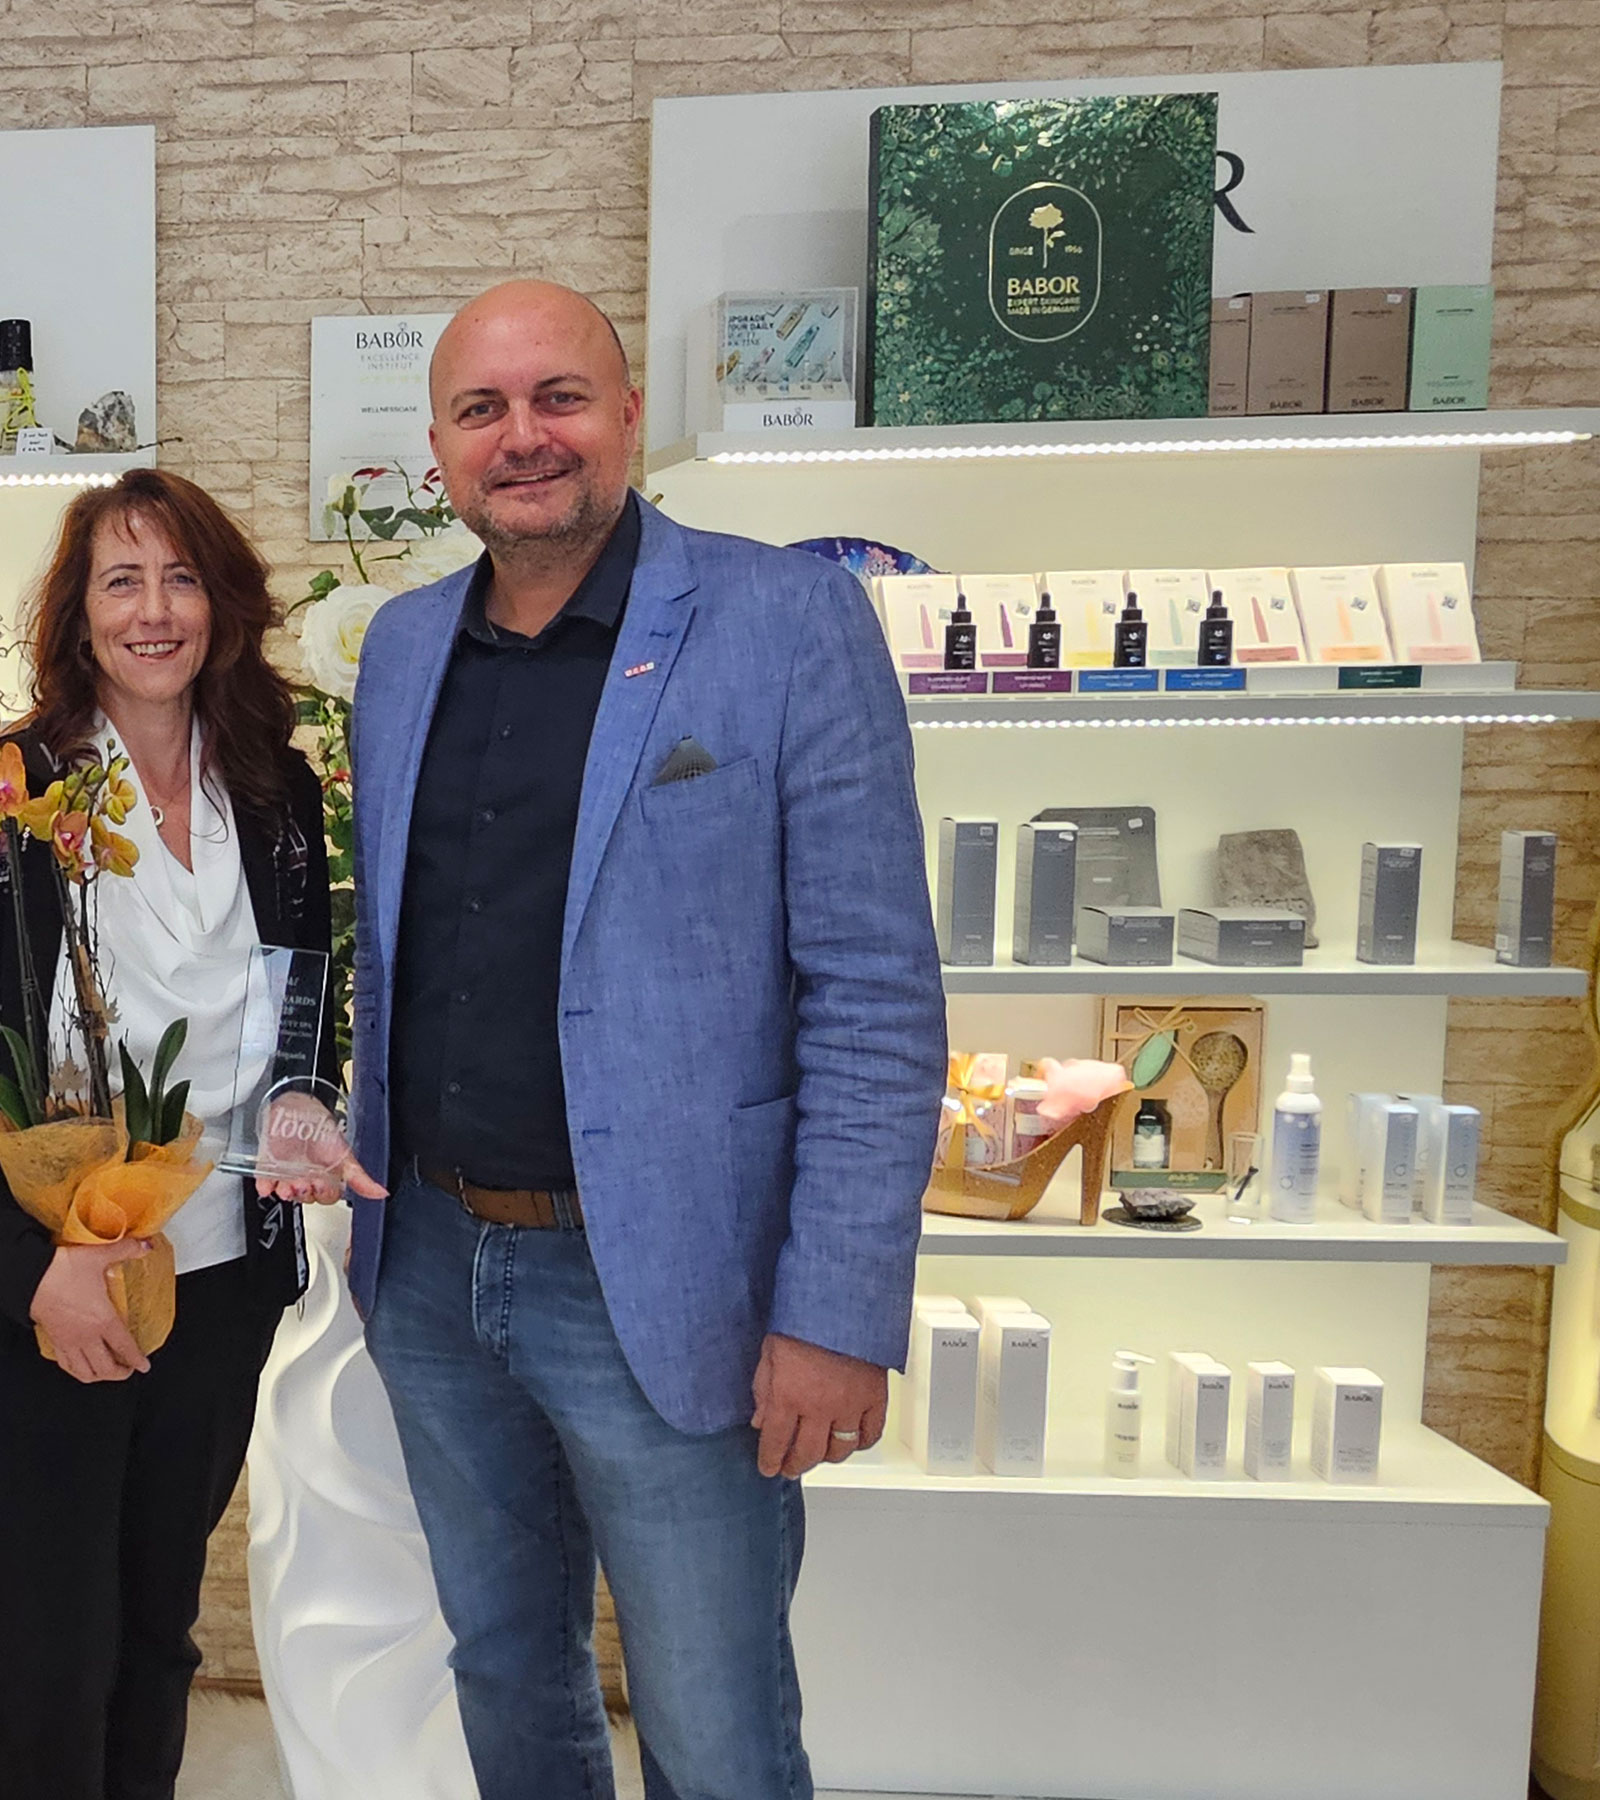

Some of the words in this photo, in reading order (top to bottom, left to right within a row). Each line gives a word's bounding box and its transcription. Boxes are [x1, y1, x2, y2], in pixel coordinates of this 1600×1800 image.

[1007, 275, 1081, 296] BABOR
[355, 329, 424, 350] BABOR
[360, 353, 420, 362] EXCELLENCE
[366, 361, 414, 370] INSTITUT
[762, 411, 814, 427] BABOR
